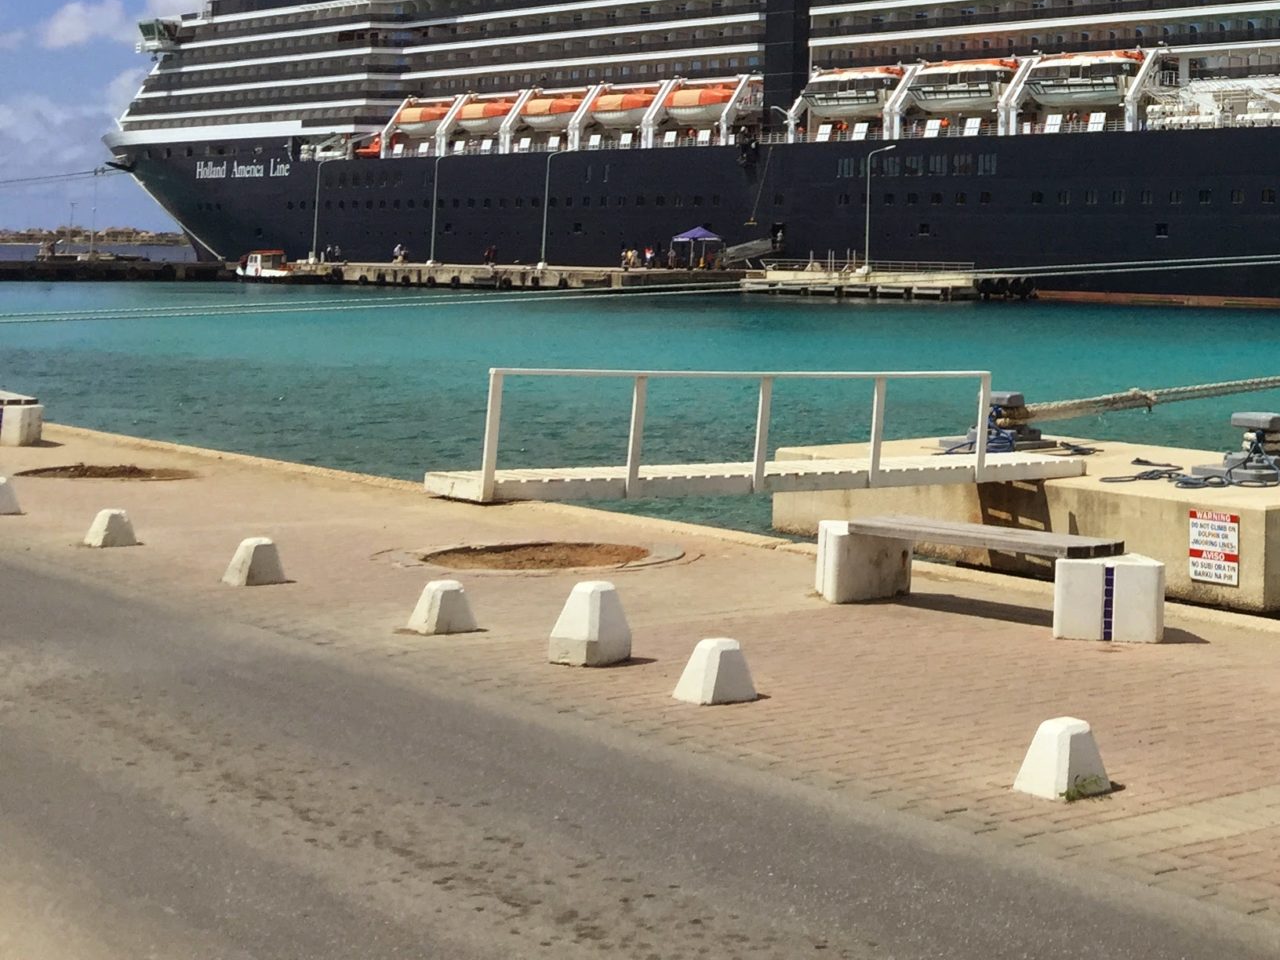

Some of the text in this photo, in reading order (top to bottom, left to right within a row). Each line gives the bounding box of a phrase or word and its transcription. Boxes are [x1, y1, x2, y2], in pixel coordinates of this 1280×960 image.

[196, 158, 290, 179] Holland America Line
[1196, 512, 1231, 522] WARNING
[1201, 551, 1226, 561] AVISO
[1191, 560, 1199, 568] NO
[1214, 572, 1222, 580] NA
